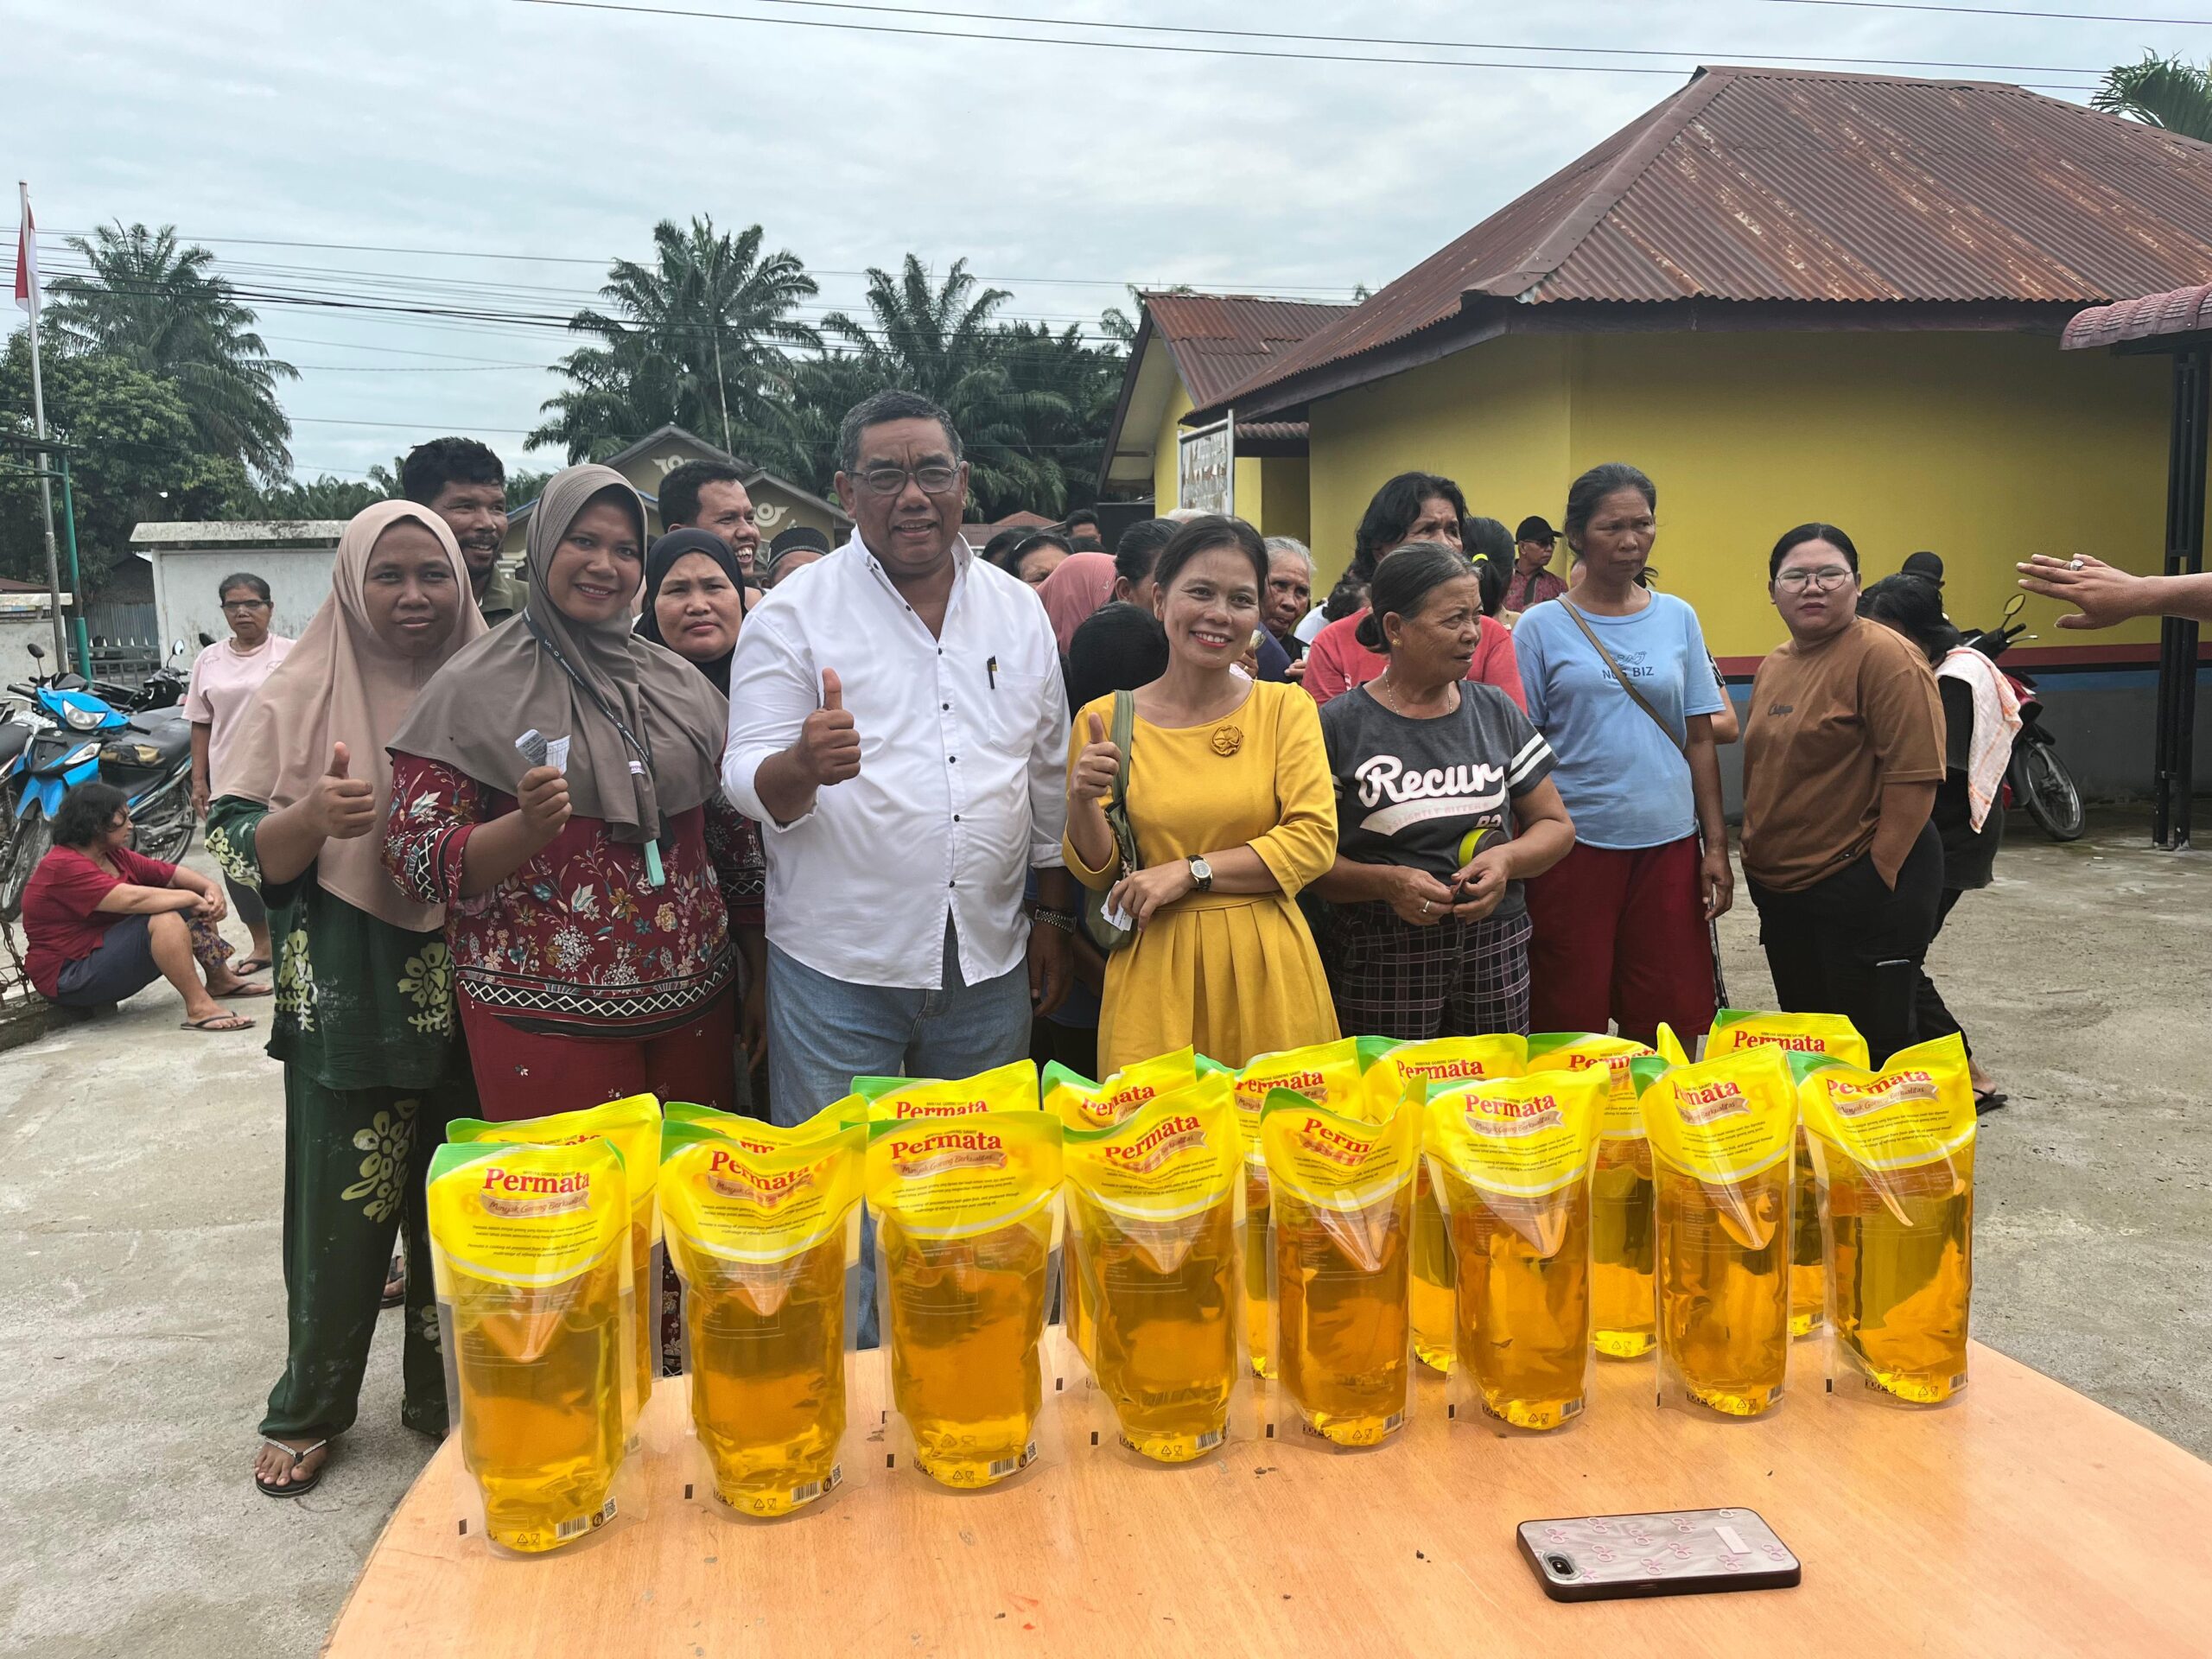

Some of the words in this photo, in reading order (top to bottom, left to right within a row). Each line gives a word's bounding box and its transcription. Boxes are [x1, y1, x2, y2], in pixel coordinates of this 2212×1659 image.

[1633, 666, 1654, 677] BIZ
[1733, 1030, 1825, 1052] Permata
[1396, 1059, 1484, 1079] Permata
[1672, 1081, 1741, 1105] Pmata
[1825, 1071, 1932, 1096] Permata
[896, 1100, 988, 1120] Permata
[1464, 1094, 1557, 1117] Permata
[890, 1132, 1002, 1160] Permata
[1103, 1116, 1201, 1160] Permata
[1301, 1117, 1374, 1153] Perm
[955, 1154, 994, 1163] Berkualitas
[482, 1168, 589, 1193] Permata
[709, 1150, 810, 1191] Permata
[489, 1201, 519, 1215] Minyak
